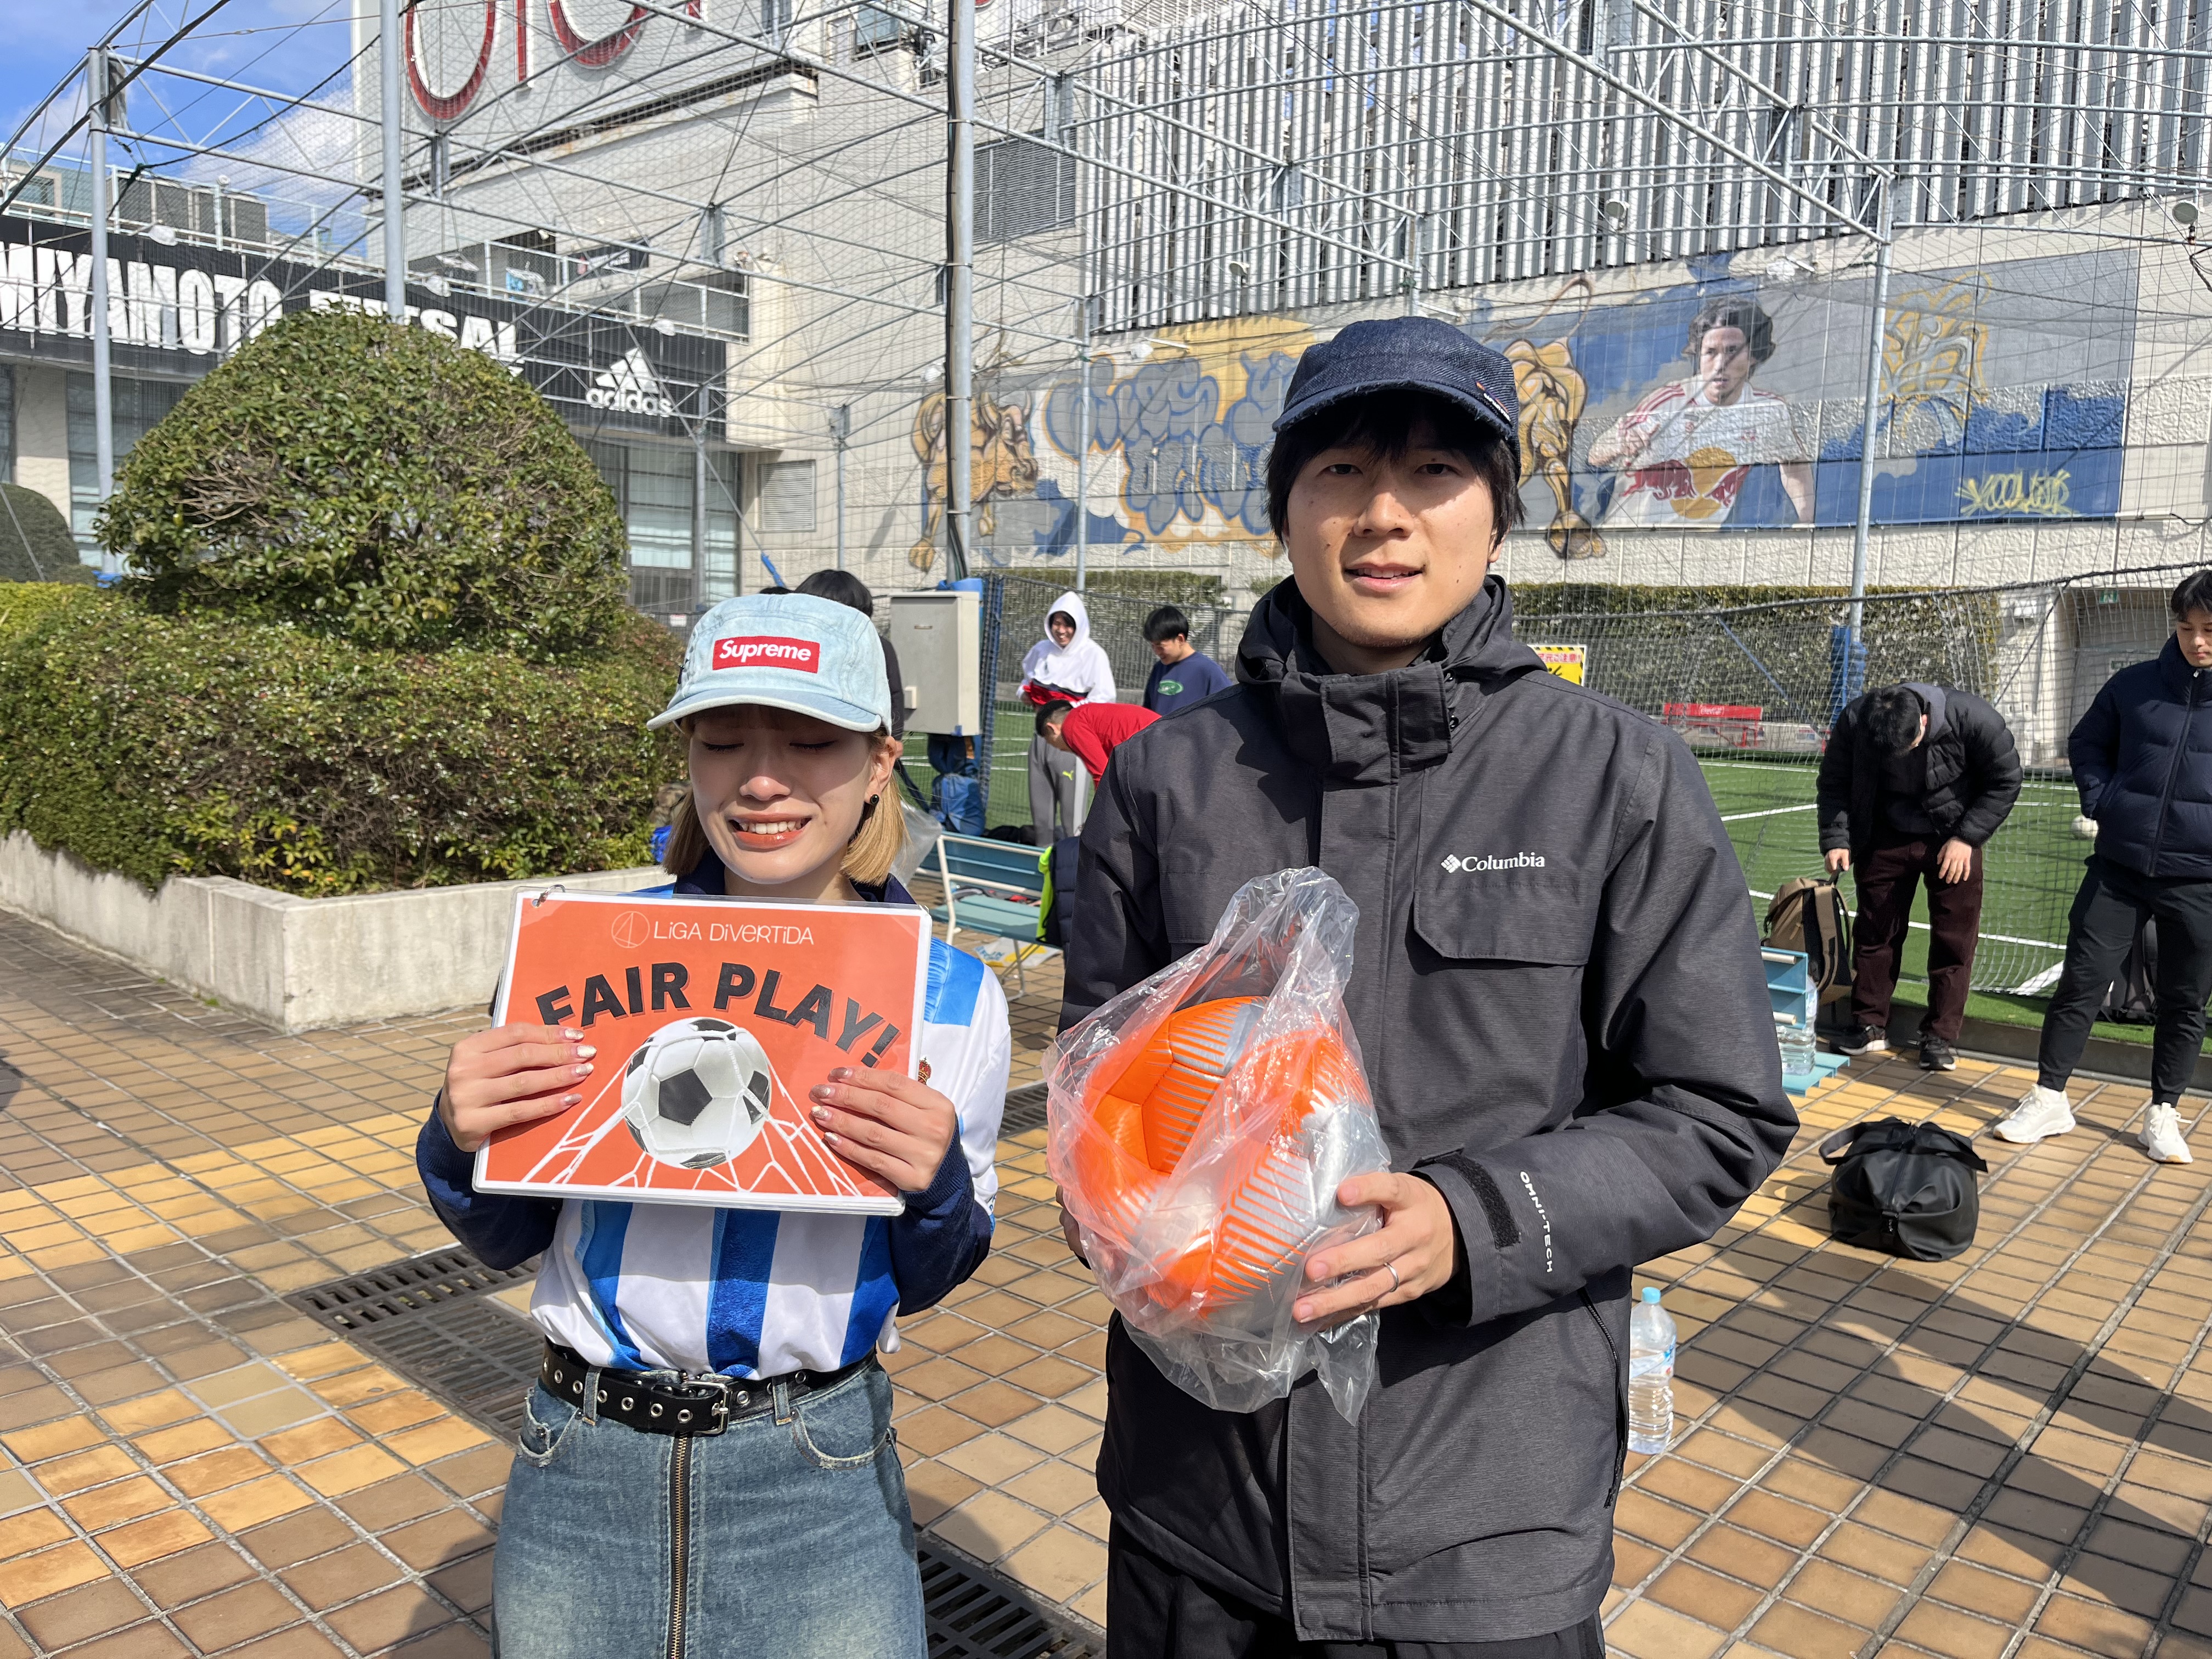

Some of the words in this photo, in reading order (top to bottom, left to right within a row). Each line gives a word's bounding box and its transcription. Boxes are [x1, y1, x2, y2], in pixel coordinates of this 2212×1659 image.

[586, 388, 673, 417] adidas
[719, 640, 811, 662] Supreme
[1462, 851, 1545, 872] Columbia
[535, 962, 692, 1027] FAIR
[713, 962, 901, 1068] PLAY!
[1520, 1171, 1553, 1272] OMNI-TECH
